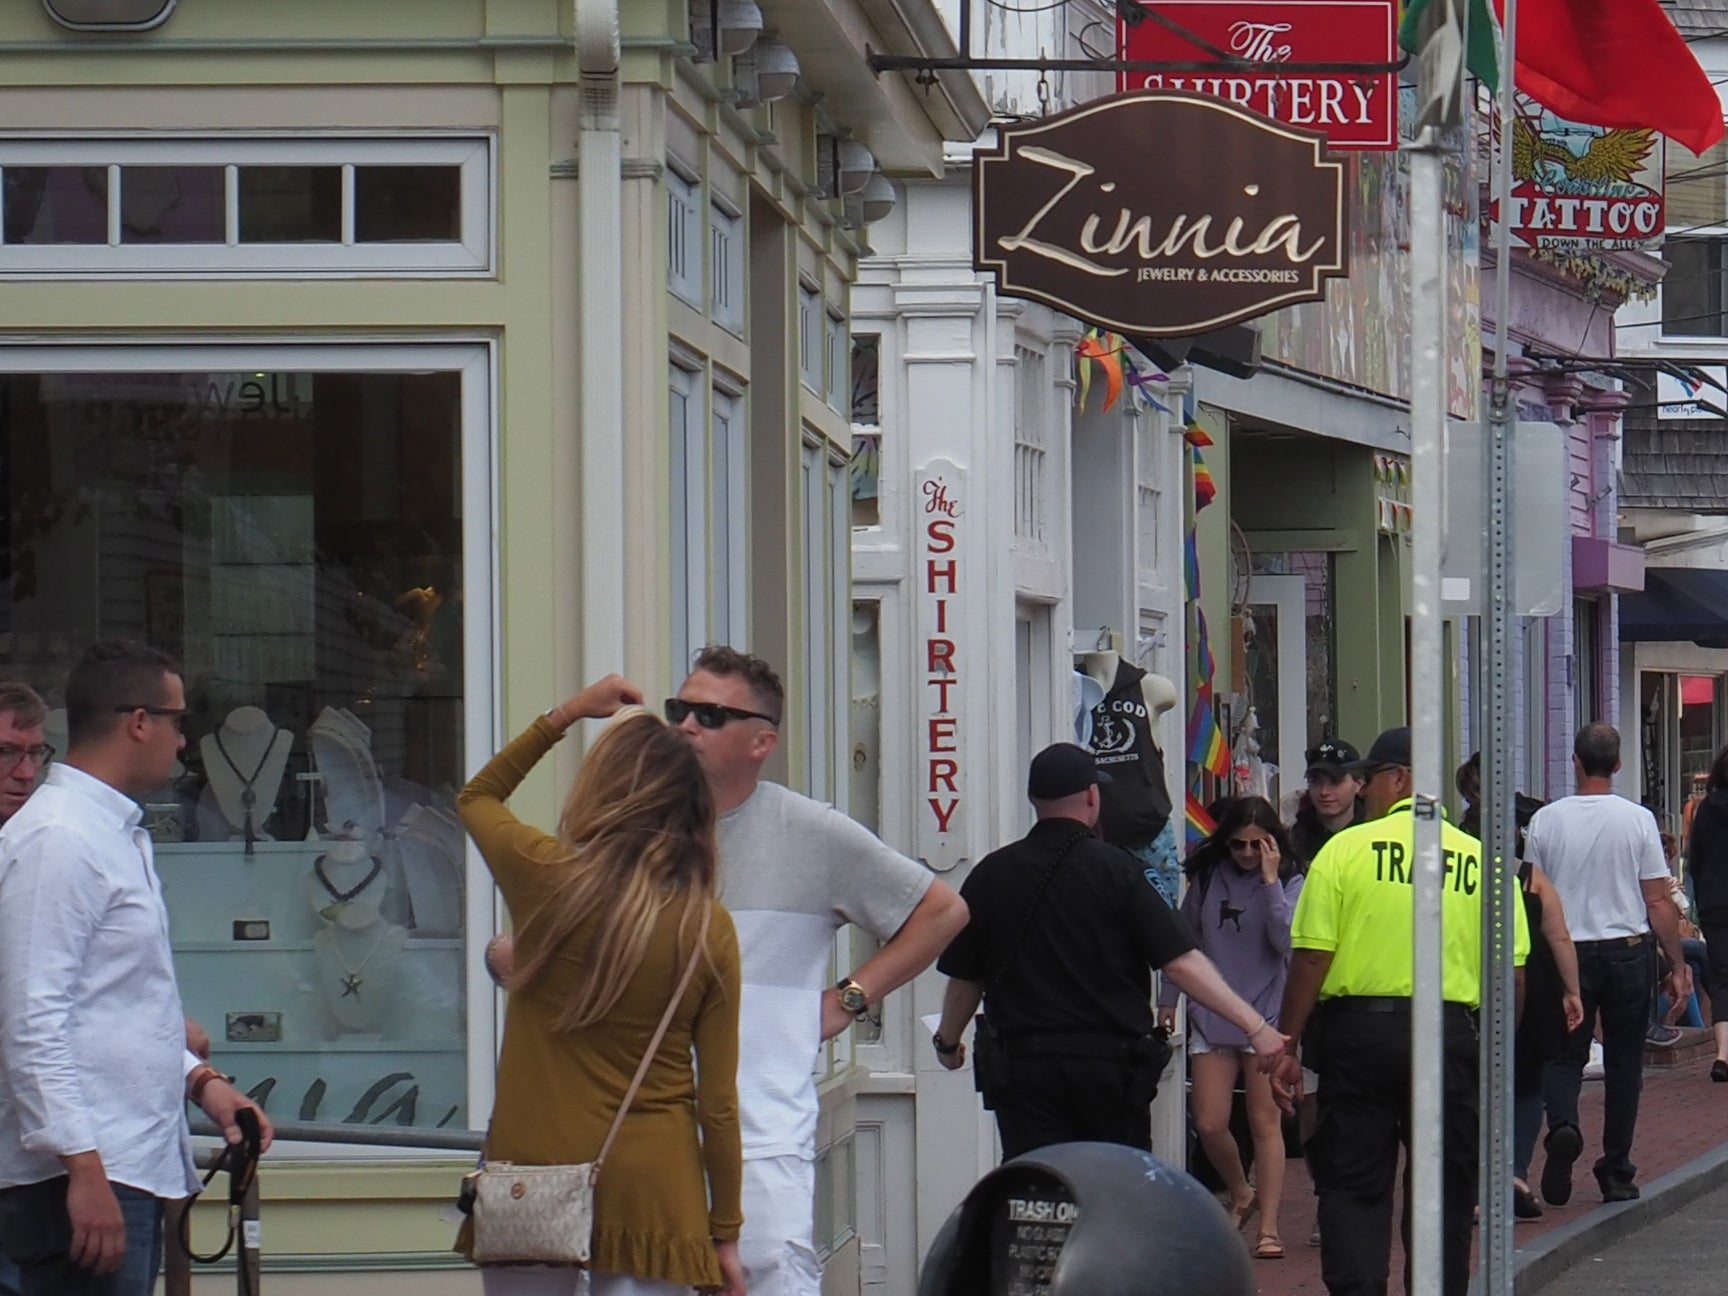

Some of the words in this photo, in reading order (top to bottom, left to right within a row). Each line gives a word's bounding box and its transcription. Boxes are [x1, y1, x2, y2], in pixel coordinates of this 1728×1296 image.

[1228, 21, 1292, 62] The
[997, 145, 1326, 276] Zinnia
[1509, 197, 1659, 234] TATTOO
[1542, 237, 1579, 250] DOWN
[1586, 238, 1606, 250] THE
[1137, 268, 1195, 282] JEWELRY
[1198, 269, 1209, 282] &
[1211, 269, 1299, 284] ACCESSORIES
[923, 480, 965, 517] The
[926, 520, 960, 833] SHIRTERY
[1112, 700, 1146, 718] COD
